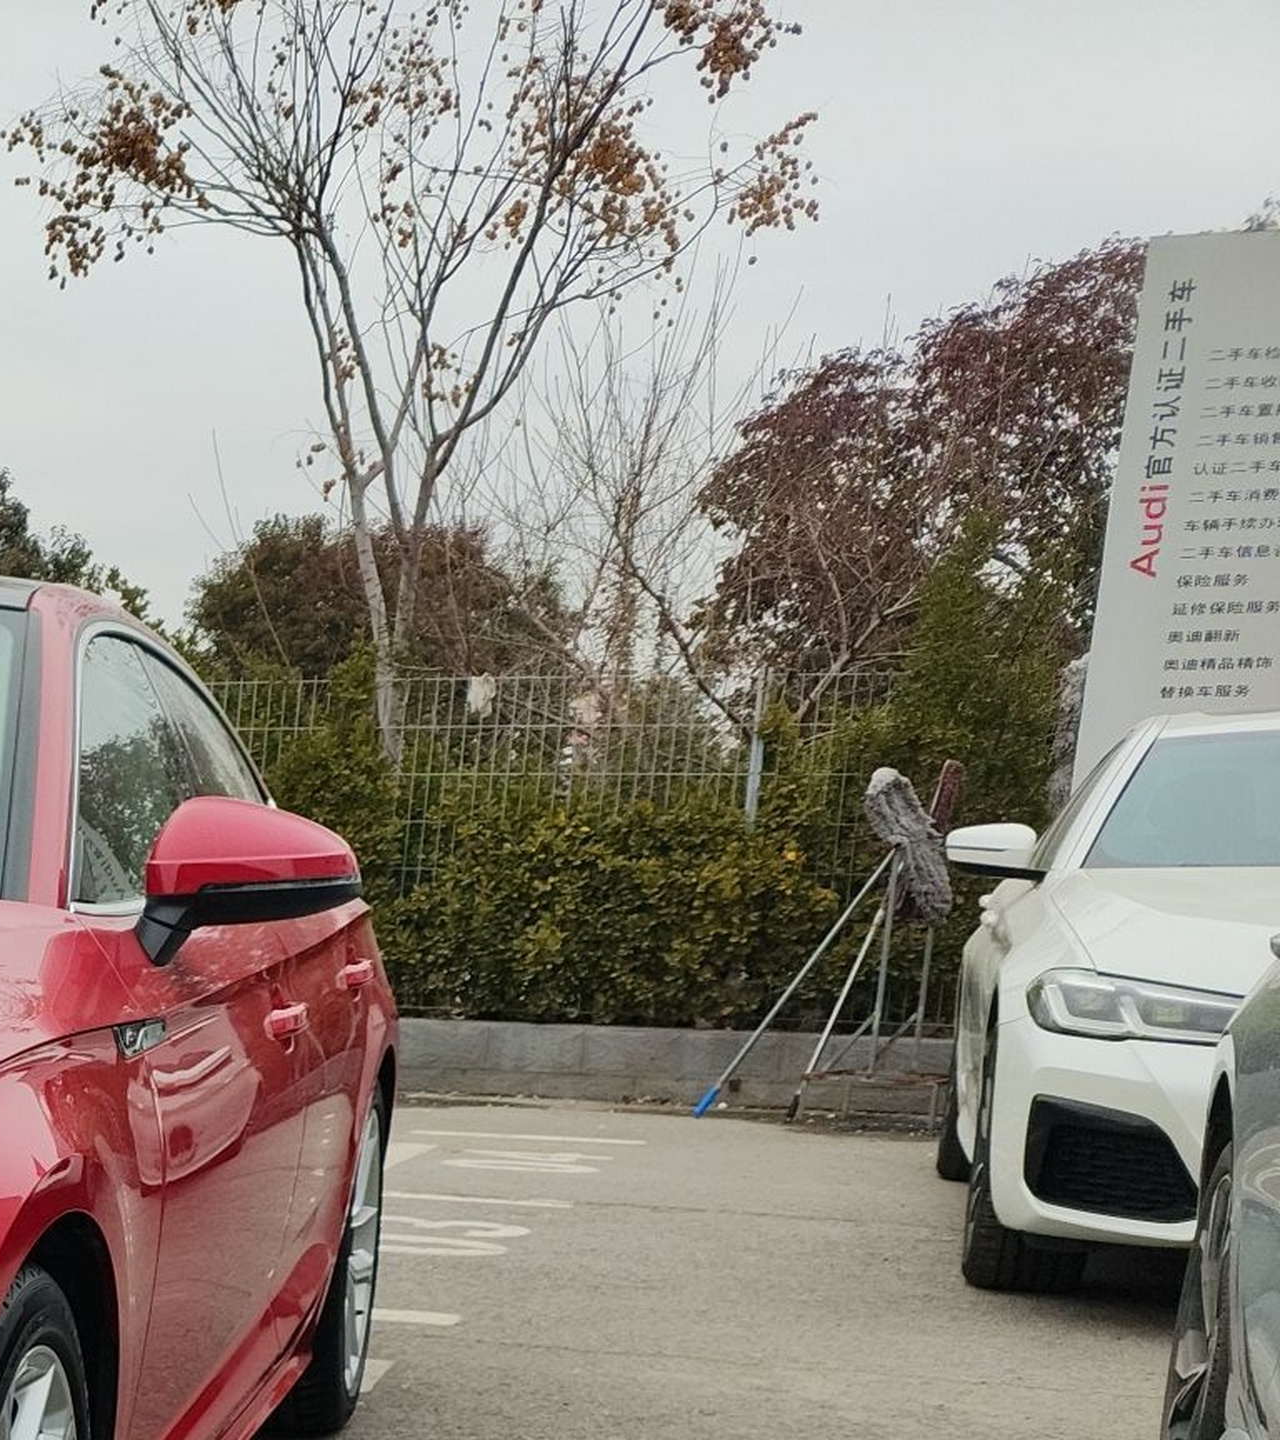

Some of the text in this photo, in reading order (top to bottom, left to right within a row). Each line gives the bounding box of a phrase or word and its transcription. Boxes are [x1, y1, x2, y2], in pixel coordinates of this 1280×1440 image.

[1183, 517, 1280, 532] 车辆手续办
[1177, 573, 1249, 588] 保险服务
